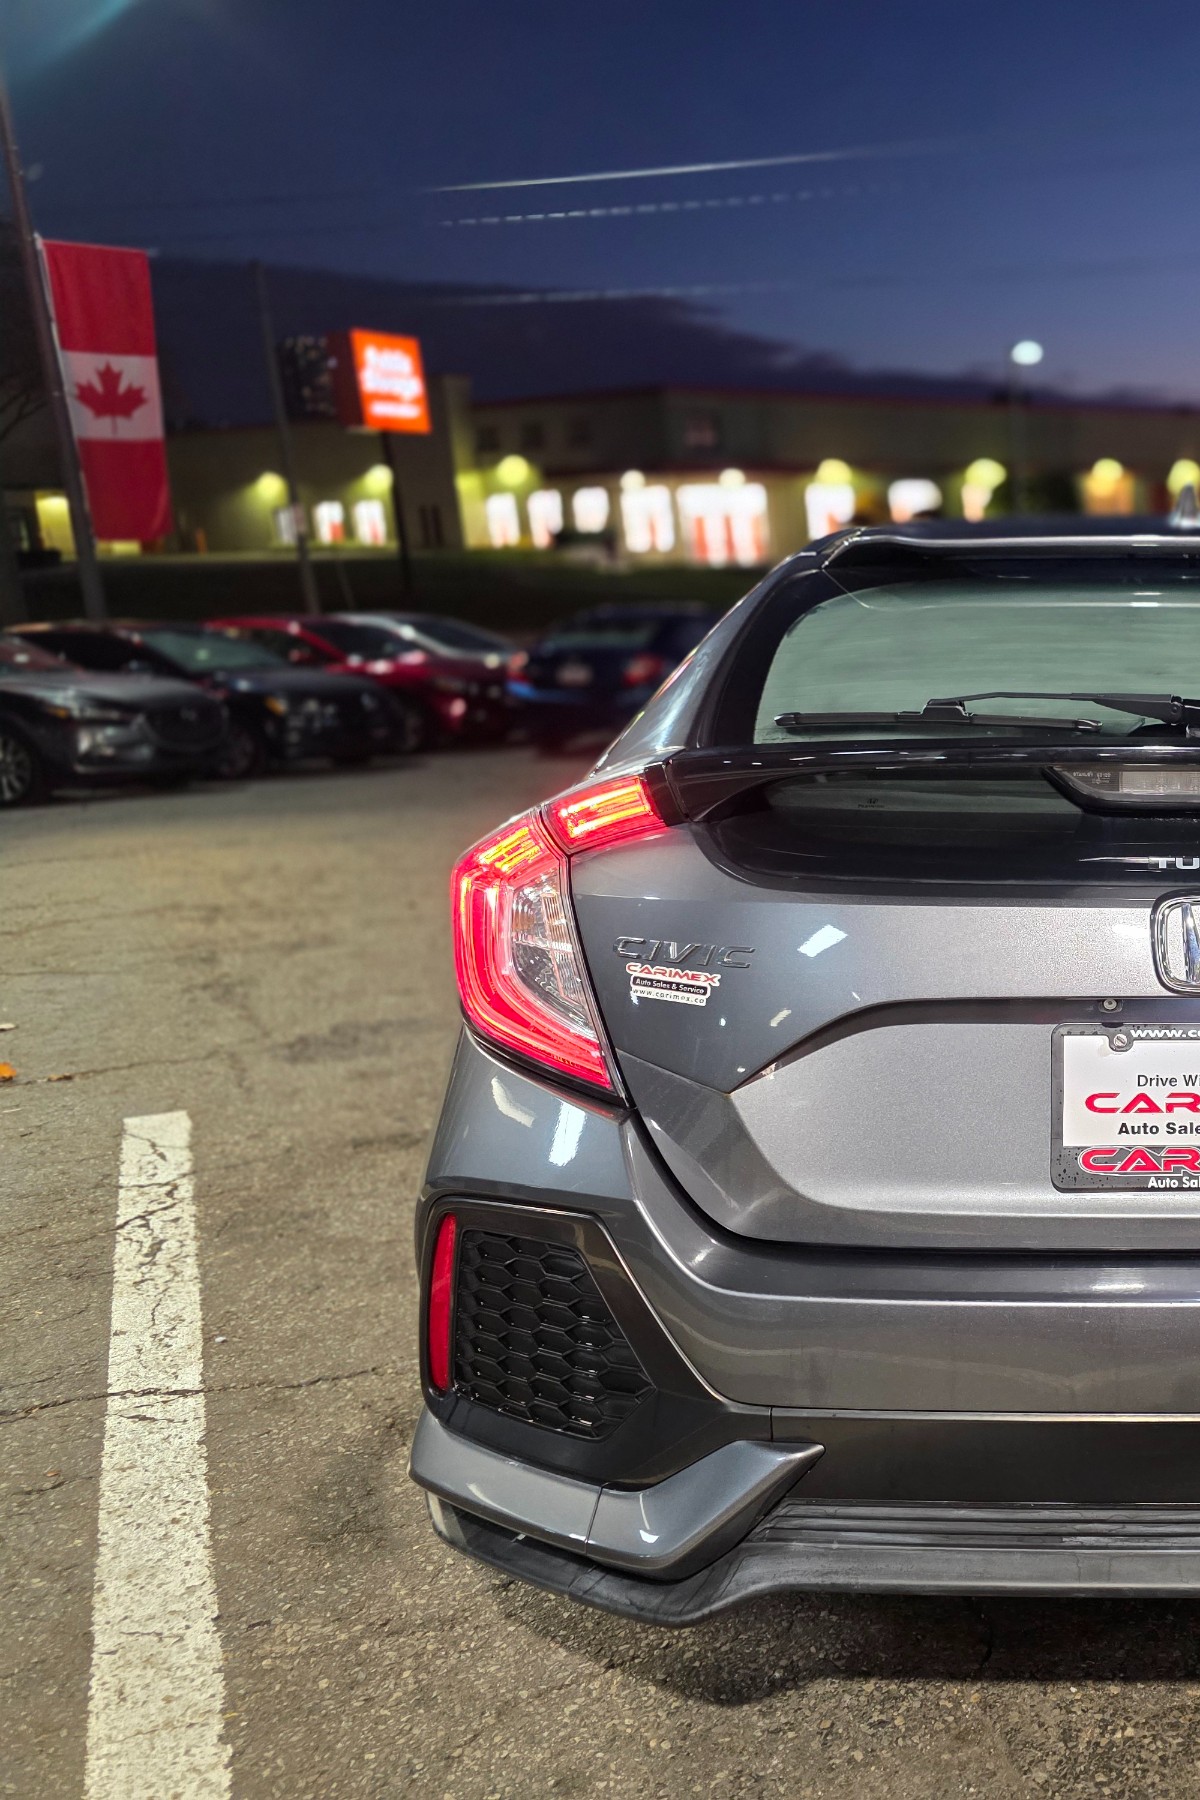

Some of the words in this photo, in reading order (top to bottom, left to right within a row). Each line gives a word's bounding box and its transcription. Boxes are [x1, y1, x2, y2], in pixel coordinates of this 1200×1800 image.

[613, 936, 755, 968] CIVIC
[626, 964, 719, 984] CARIMEX
[635, 979, 651, 987] Auto
[652, 980, 670, 989] Sales
[679, 984, 705, 995] Service
[1136, 1074, 1178, 1088] Drive
[1117, 1121, 1159, 1135] Auto
[1148, 1176, 1180, 1189] Auto
